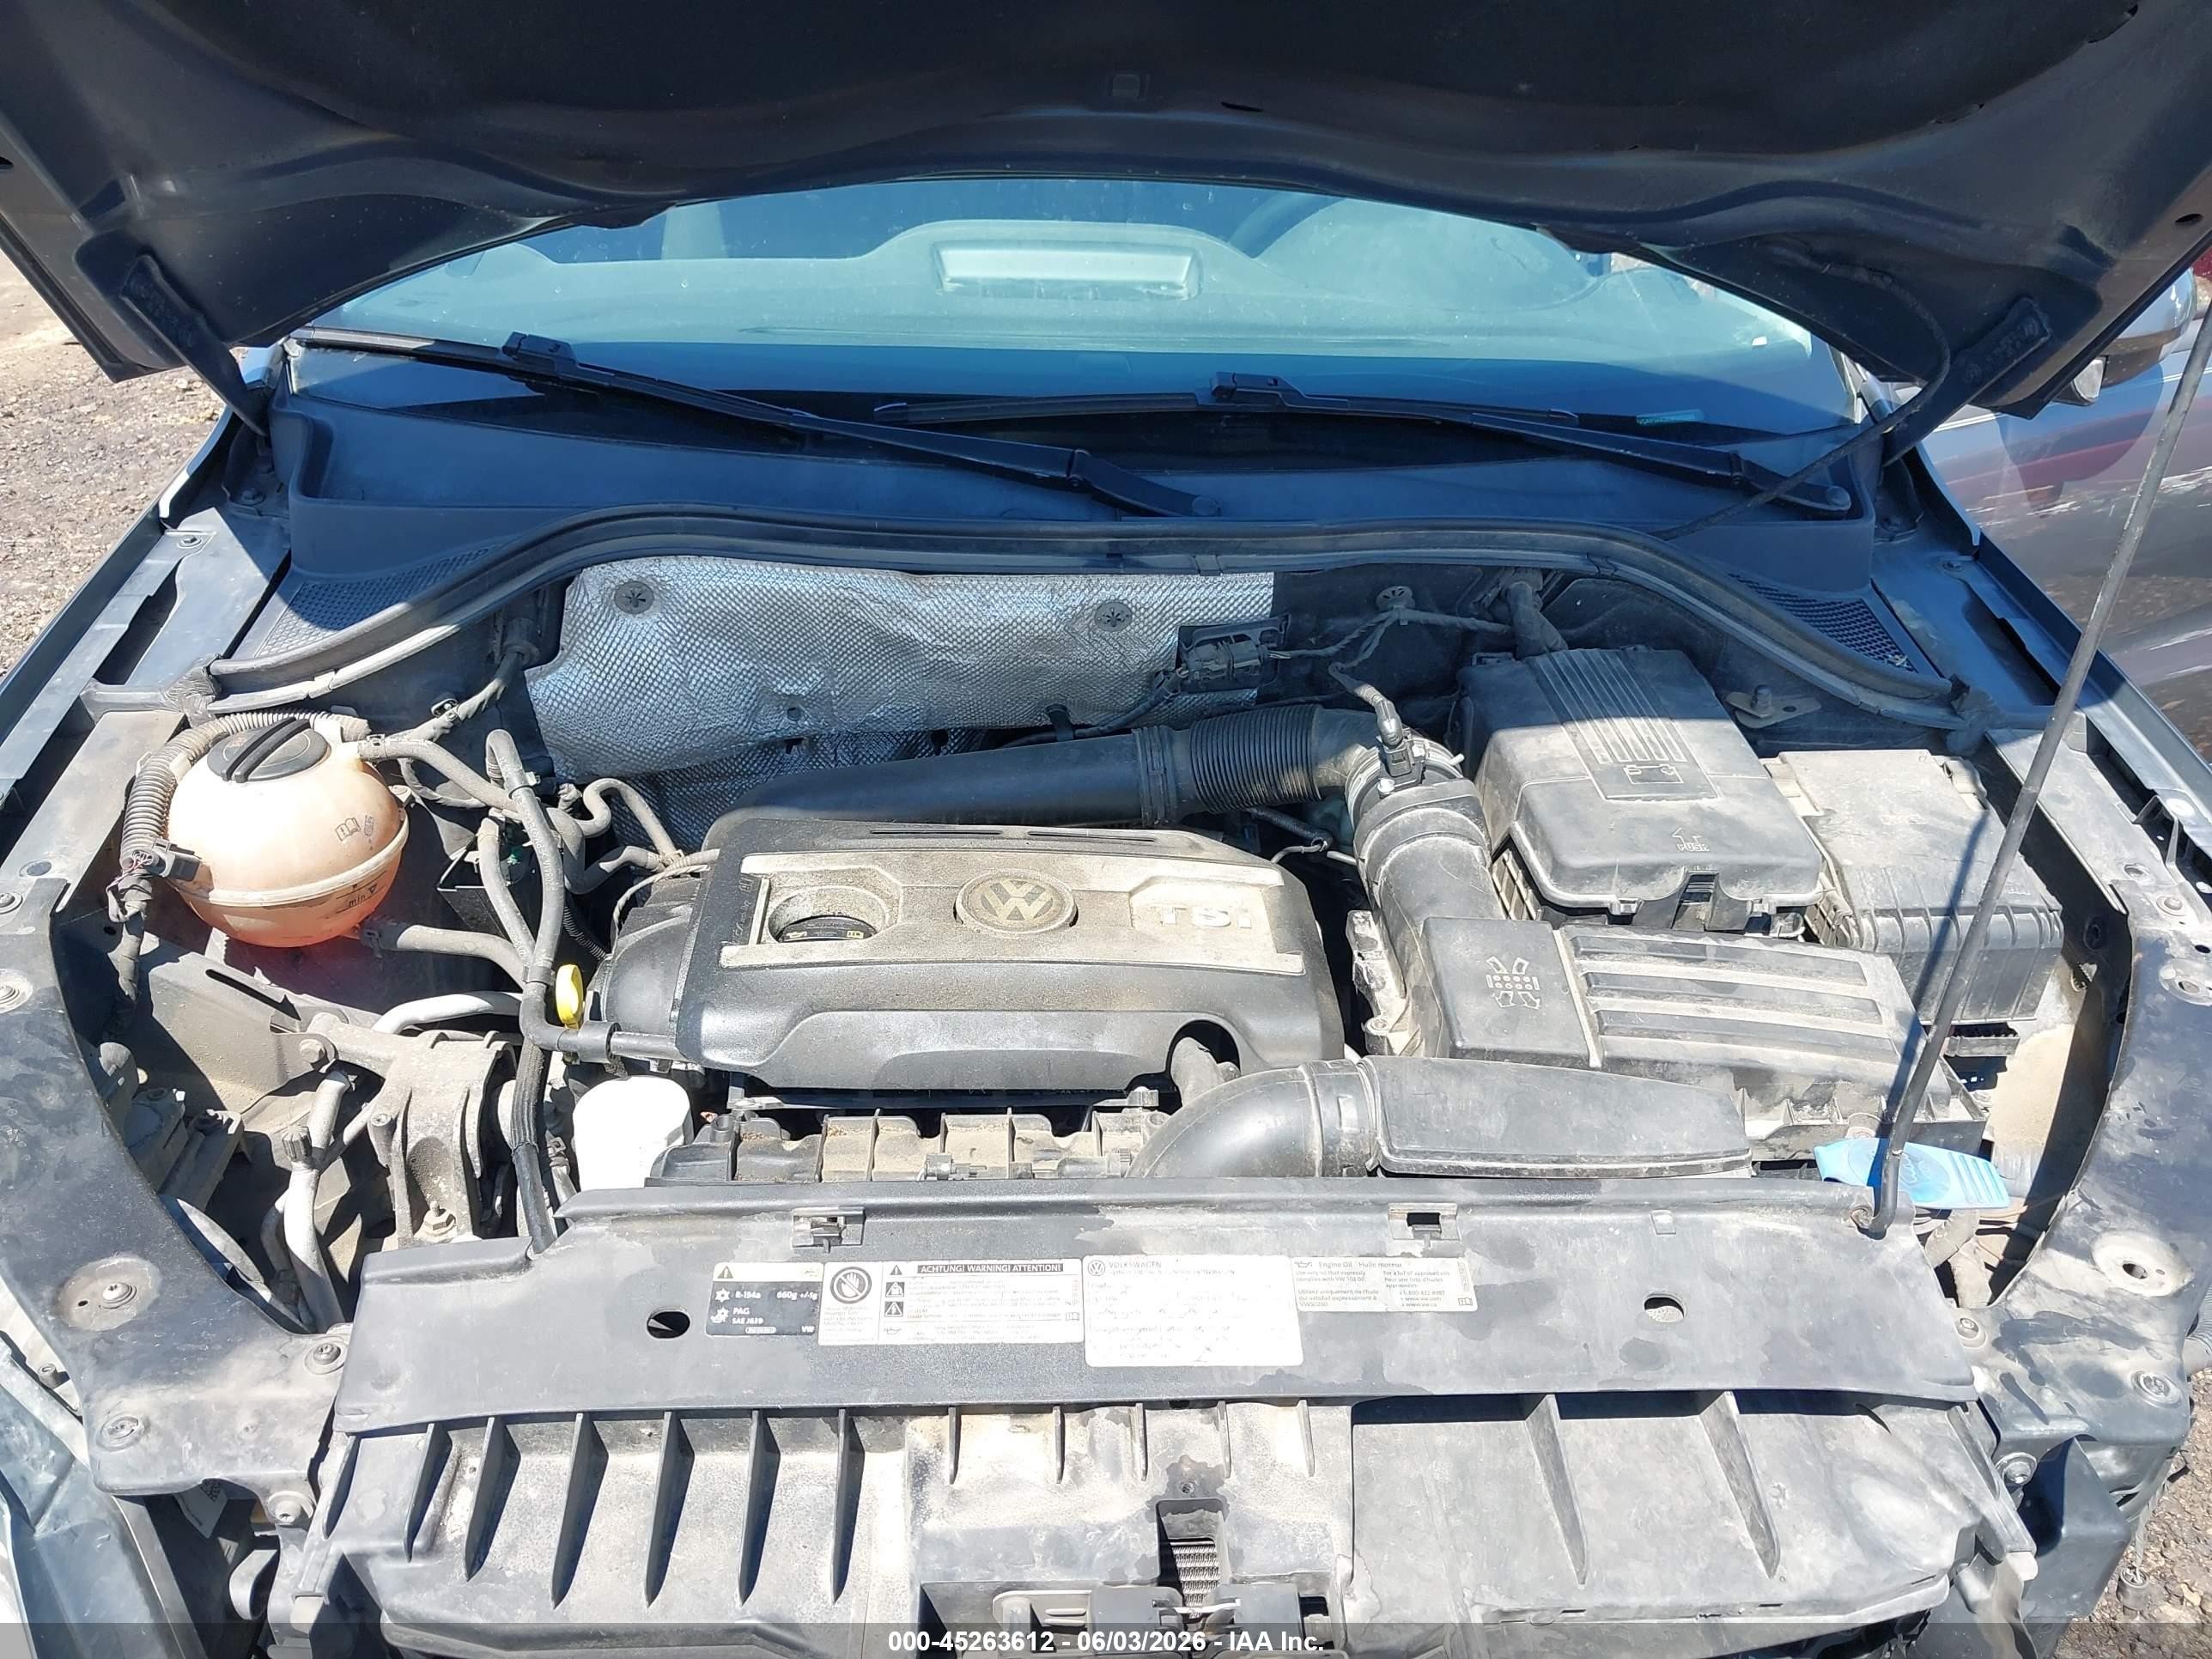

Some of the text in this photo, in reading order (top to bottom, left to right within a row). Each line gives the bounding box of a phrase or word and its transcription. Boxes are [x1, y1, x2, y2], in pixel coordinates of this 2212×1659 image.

[349, 894, 367, 908] min
[921, 1263, 1061, 1273] ACHTUNG! WARNING! ATTENTION!
[1109, 1261, 1162, 1269] VOLKSWAGEN
[801, 1325, 816, 1334] VW
